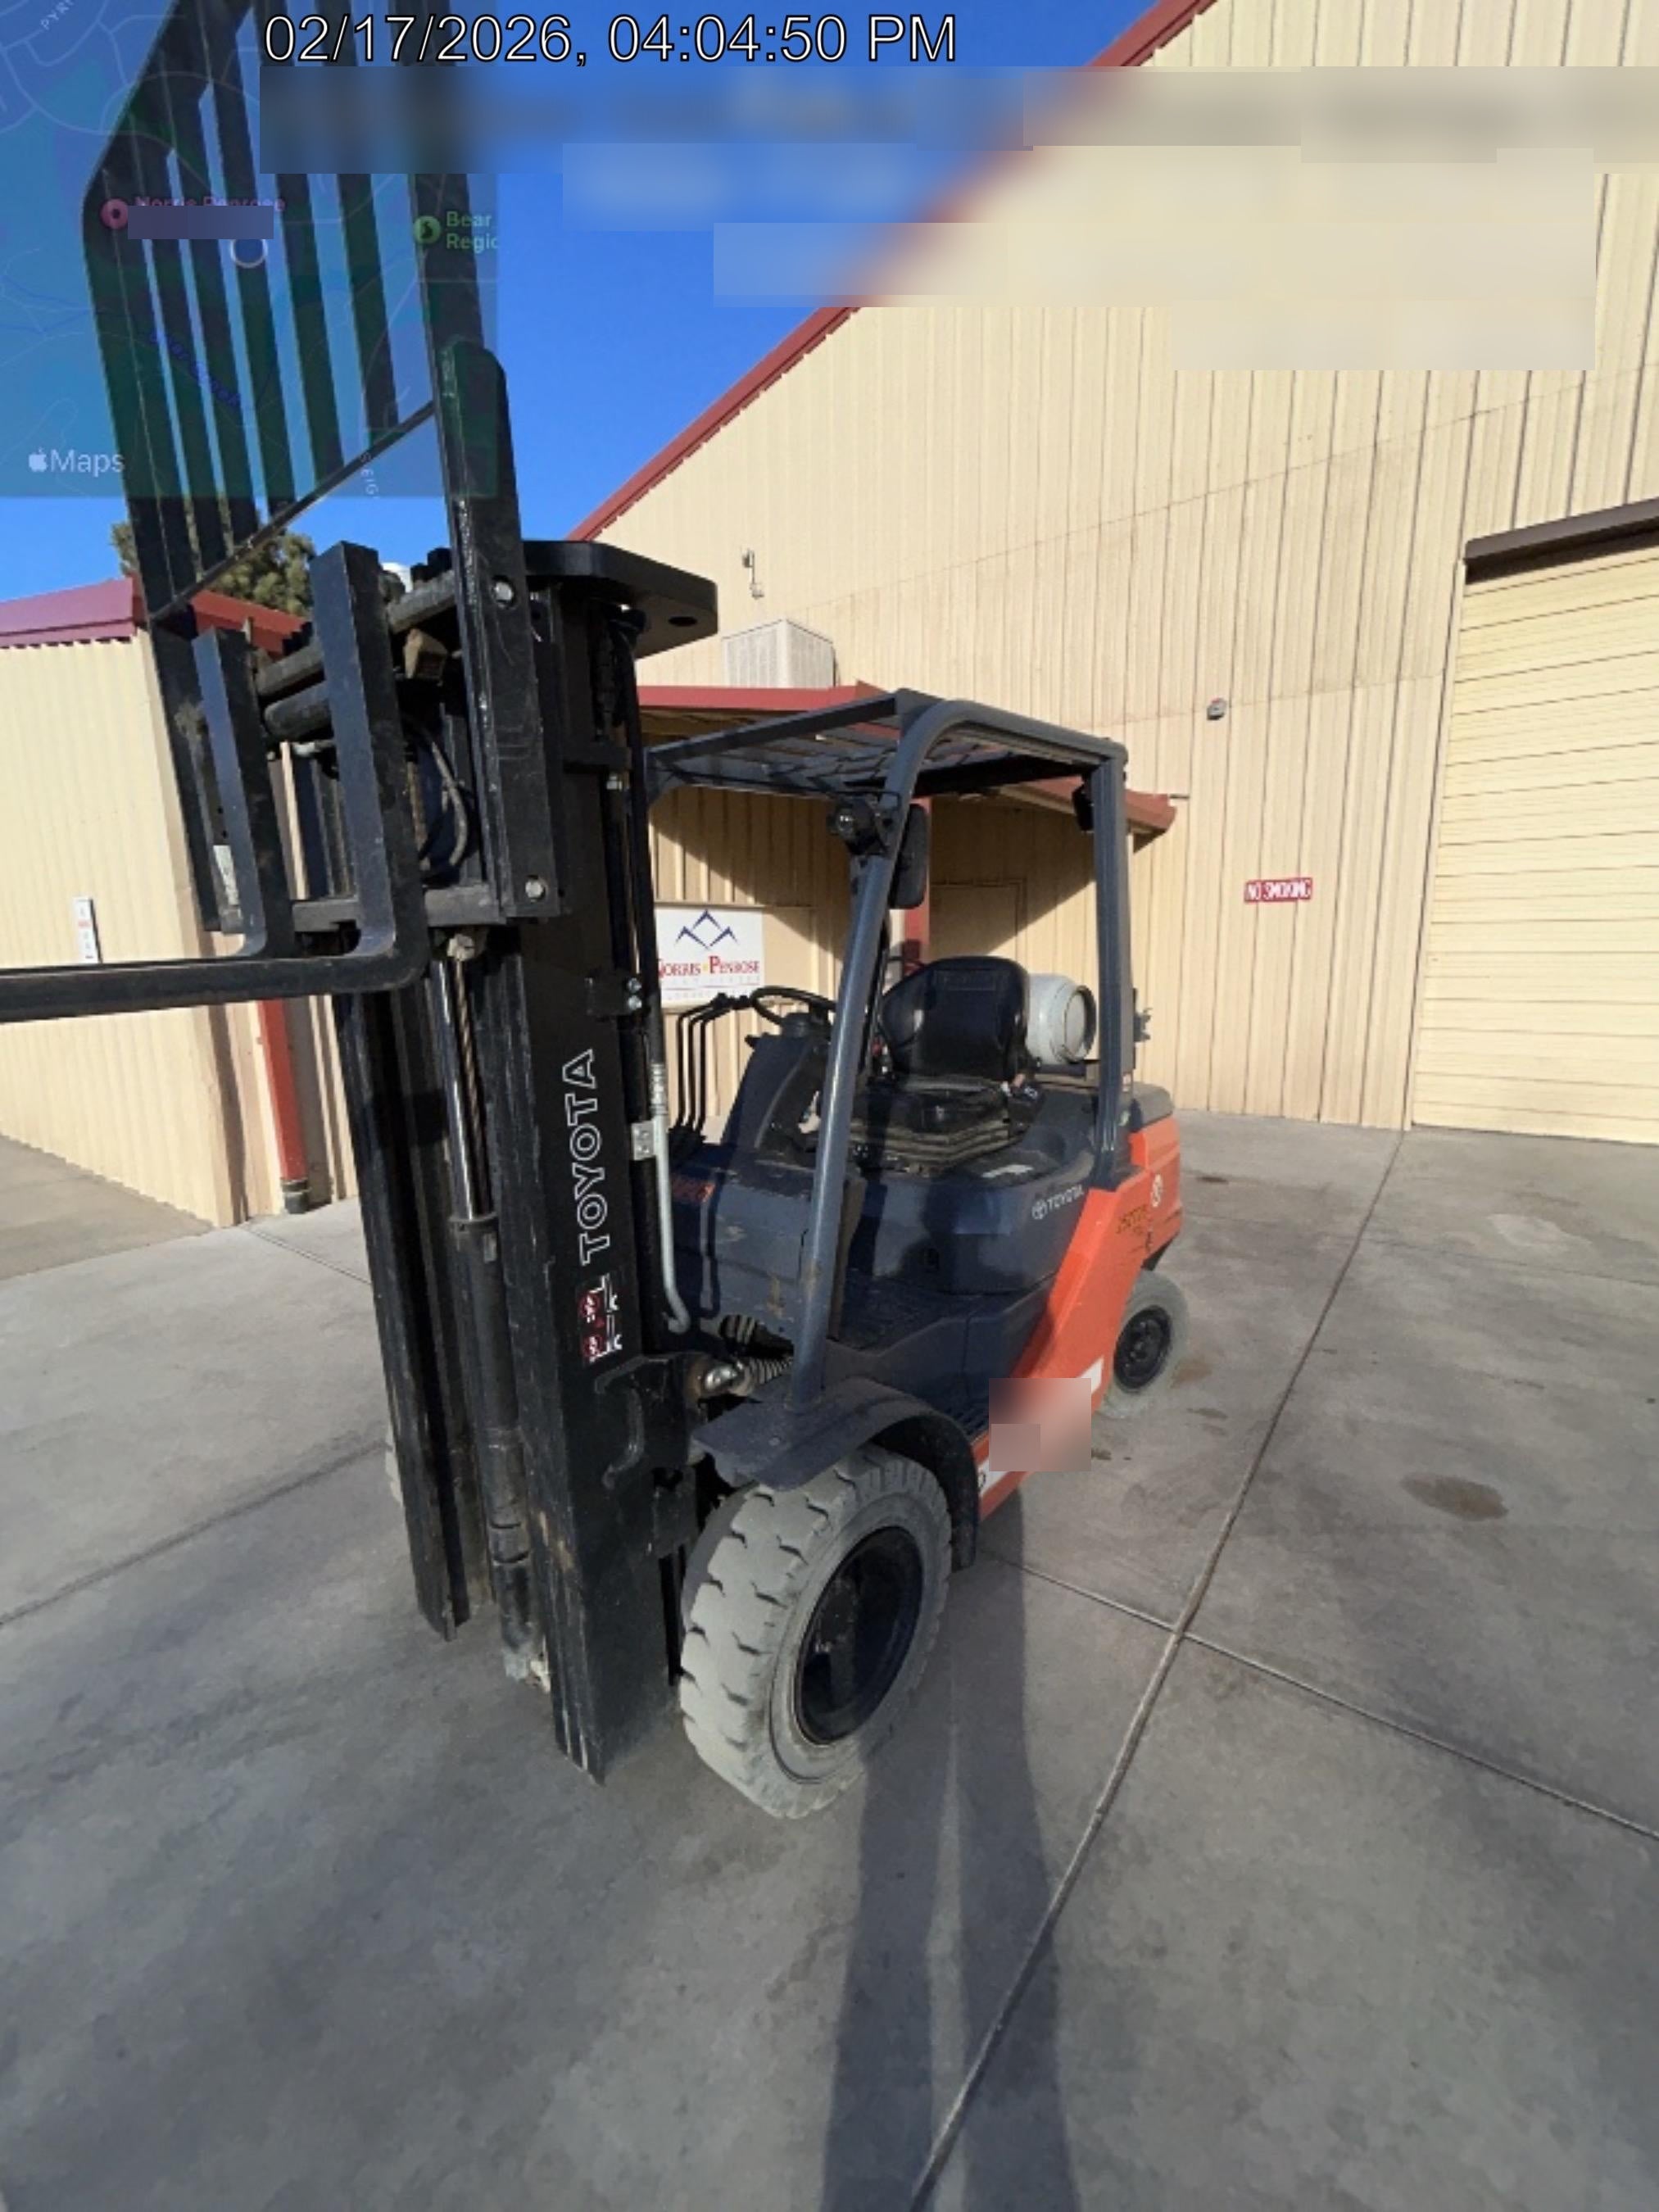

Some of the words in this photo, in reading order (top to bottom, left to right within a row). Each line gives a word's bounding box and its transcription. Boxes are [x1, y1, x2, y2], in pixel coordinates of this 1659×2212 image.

[1247, 882, 1262, 902] NO
[1262, 879, 1312, 900] SMOKING
[561, 1048, 611, 1267] TOYOTA
[1047, 1184, 1085, 1212] TOYOTA
